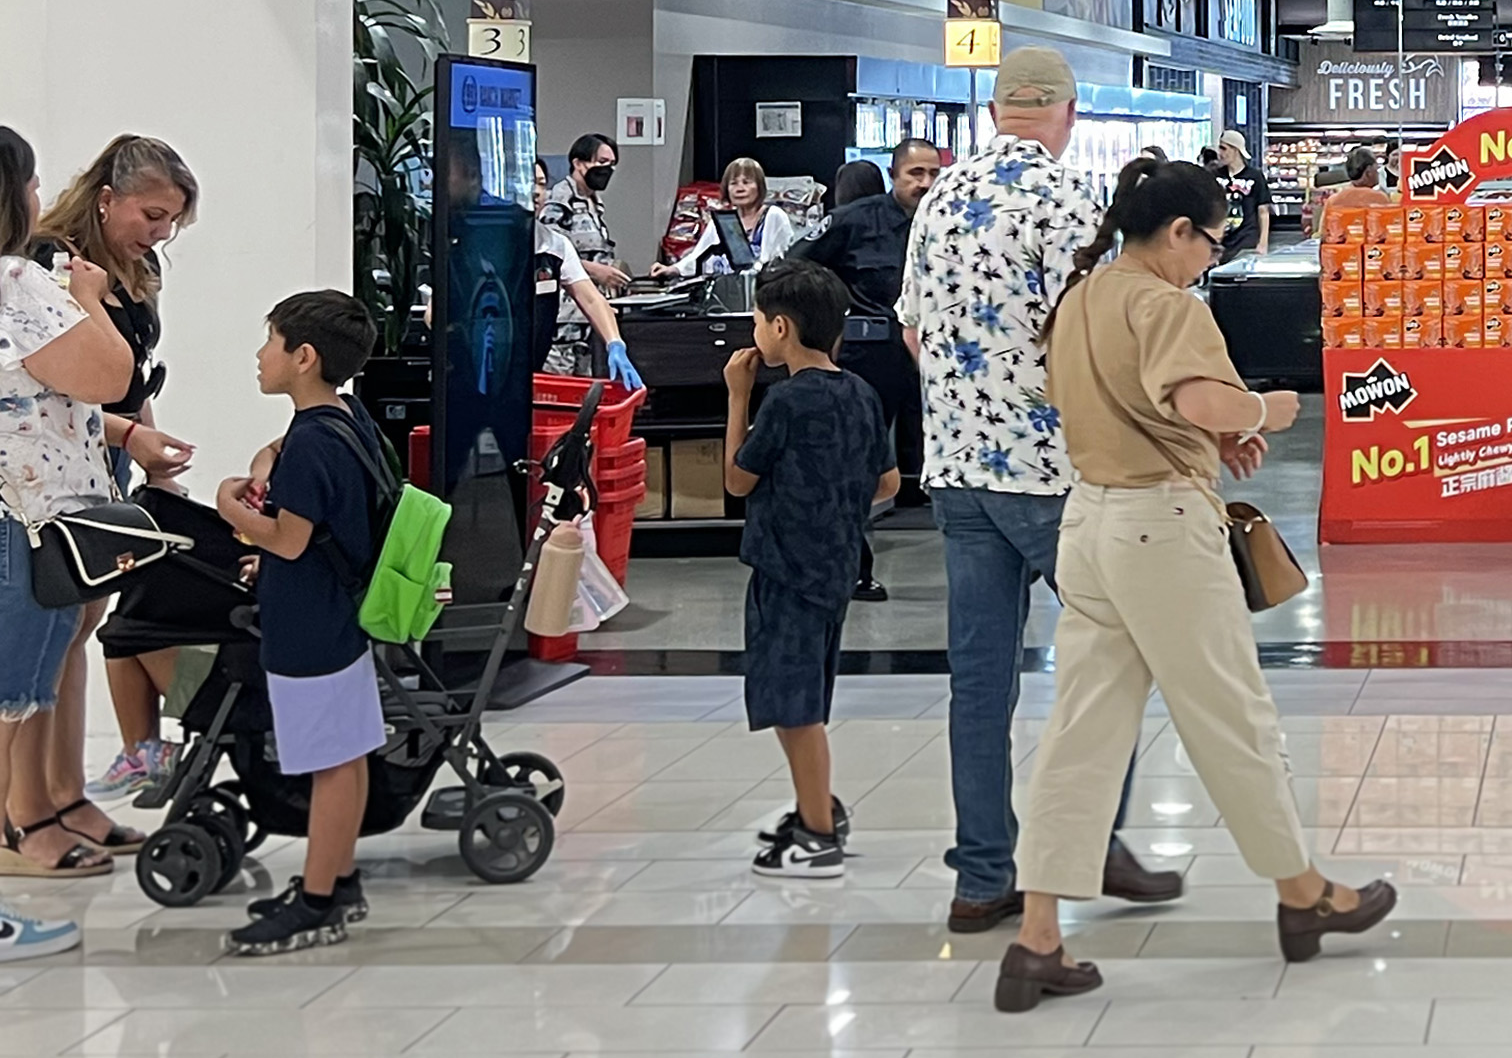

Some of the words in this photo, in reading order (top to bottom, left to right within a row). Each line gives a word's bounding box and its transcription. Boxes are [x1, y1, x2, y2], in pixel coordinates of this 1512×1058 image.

[480, 27, 502, 56] 3
[516, 28, 526, 57] 3
[956, 28, 981, 56] 4
[1317, 60, 1395, 79] Deliciously
[1329, 77, 1426, 110] FRESH
[1408, 158, 1470, 190] MOWON
[1339, 372, 1410, 411] MOWON
[1437, 423, 1502, 448] Sesame
[1352, 435, 1430, 485] No.1
[1438, 448, 1477, 467] Lightly
